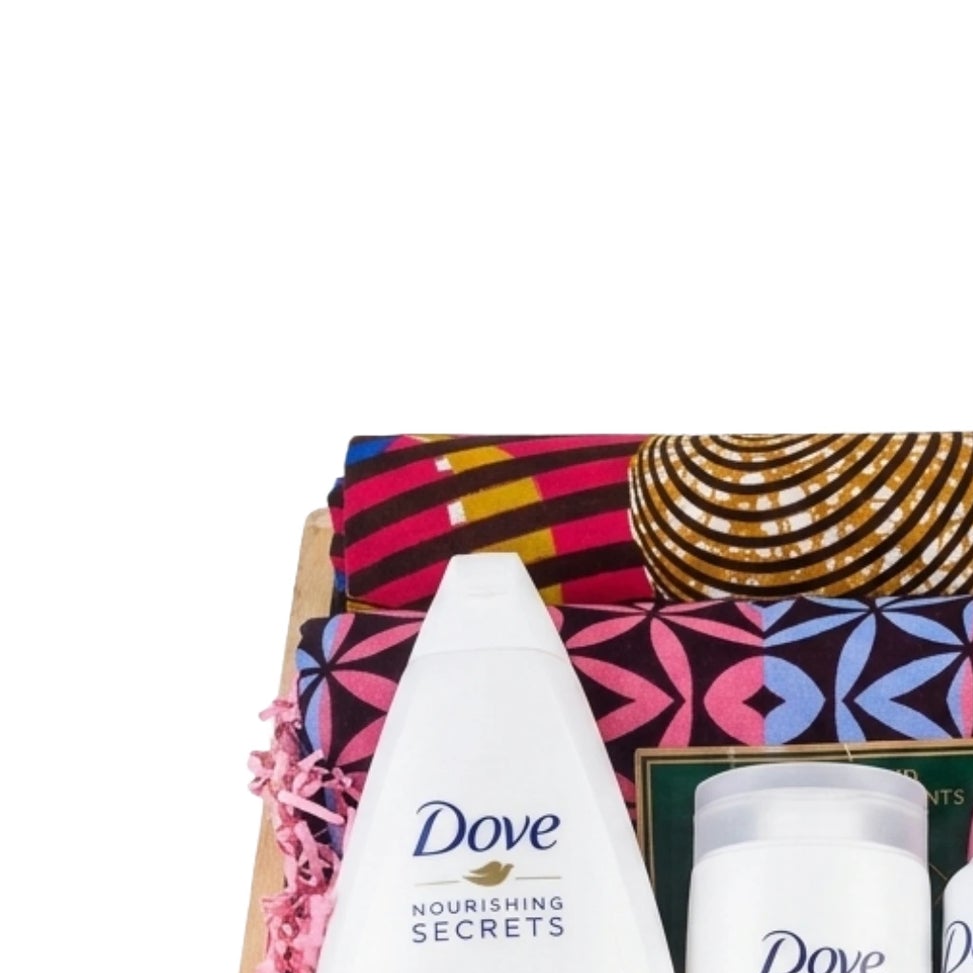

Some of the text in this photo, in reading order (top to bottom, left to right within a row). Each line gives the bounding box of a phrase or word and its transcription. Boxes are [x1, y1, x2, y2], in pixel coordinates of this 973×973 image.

[412, 800, 561, 857] Dove
[411, 896, 564, 916] NOURISHING
[411, 916, 565, 944] SECRETS
